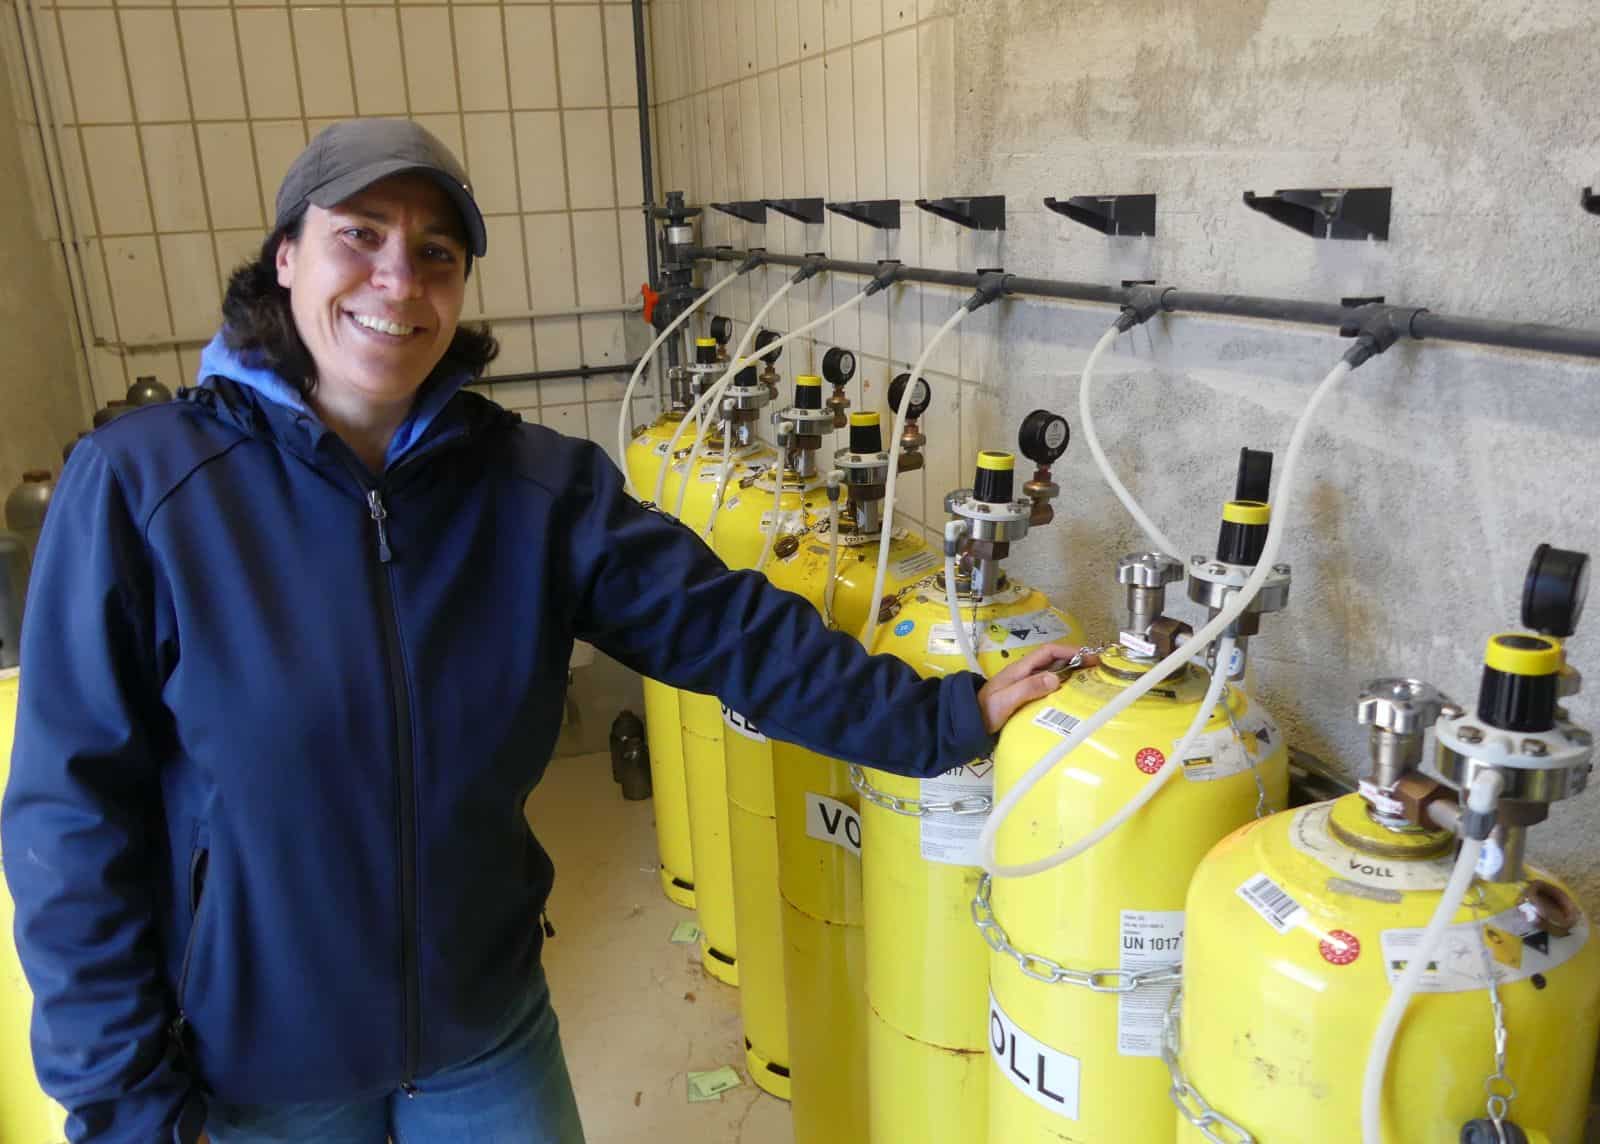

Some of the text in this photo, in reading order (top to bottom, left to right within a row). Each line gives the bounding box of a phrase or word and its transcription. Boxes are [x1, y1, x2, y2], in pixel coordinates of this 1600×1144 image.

[818, 802, 861, 848] VO
[1350, 859, 1393, 878] VOLL
[1123, 935, 1180, 951] UN 1017
